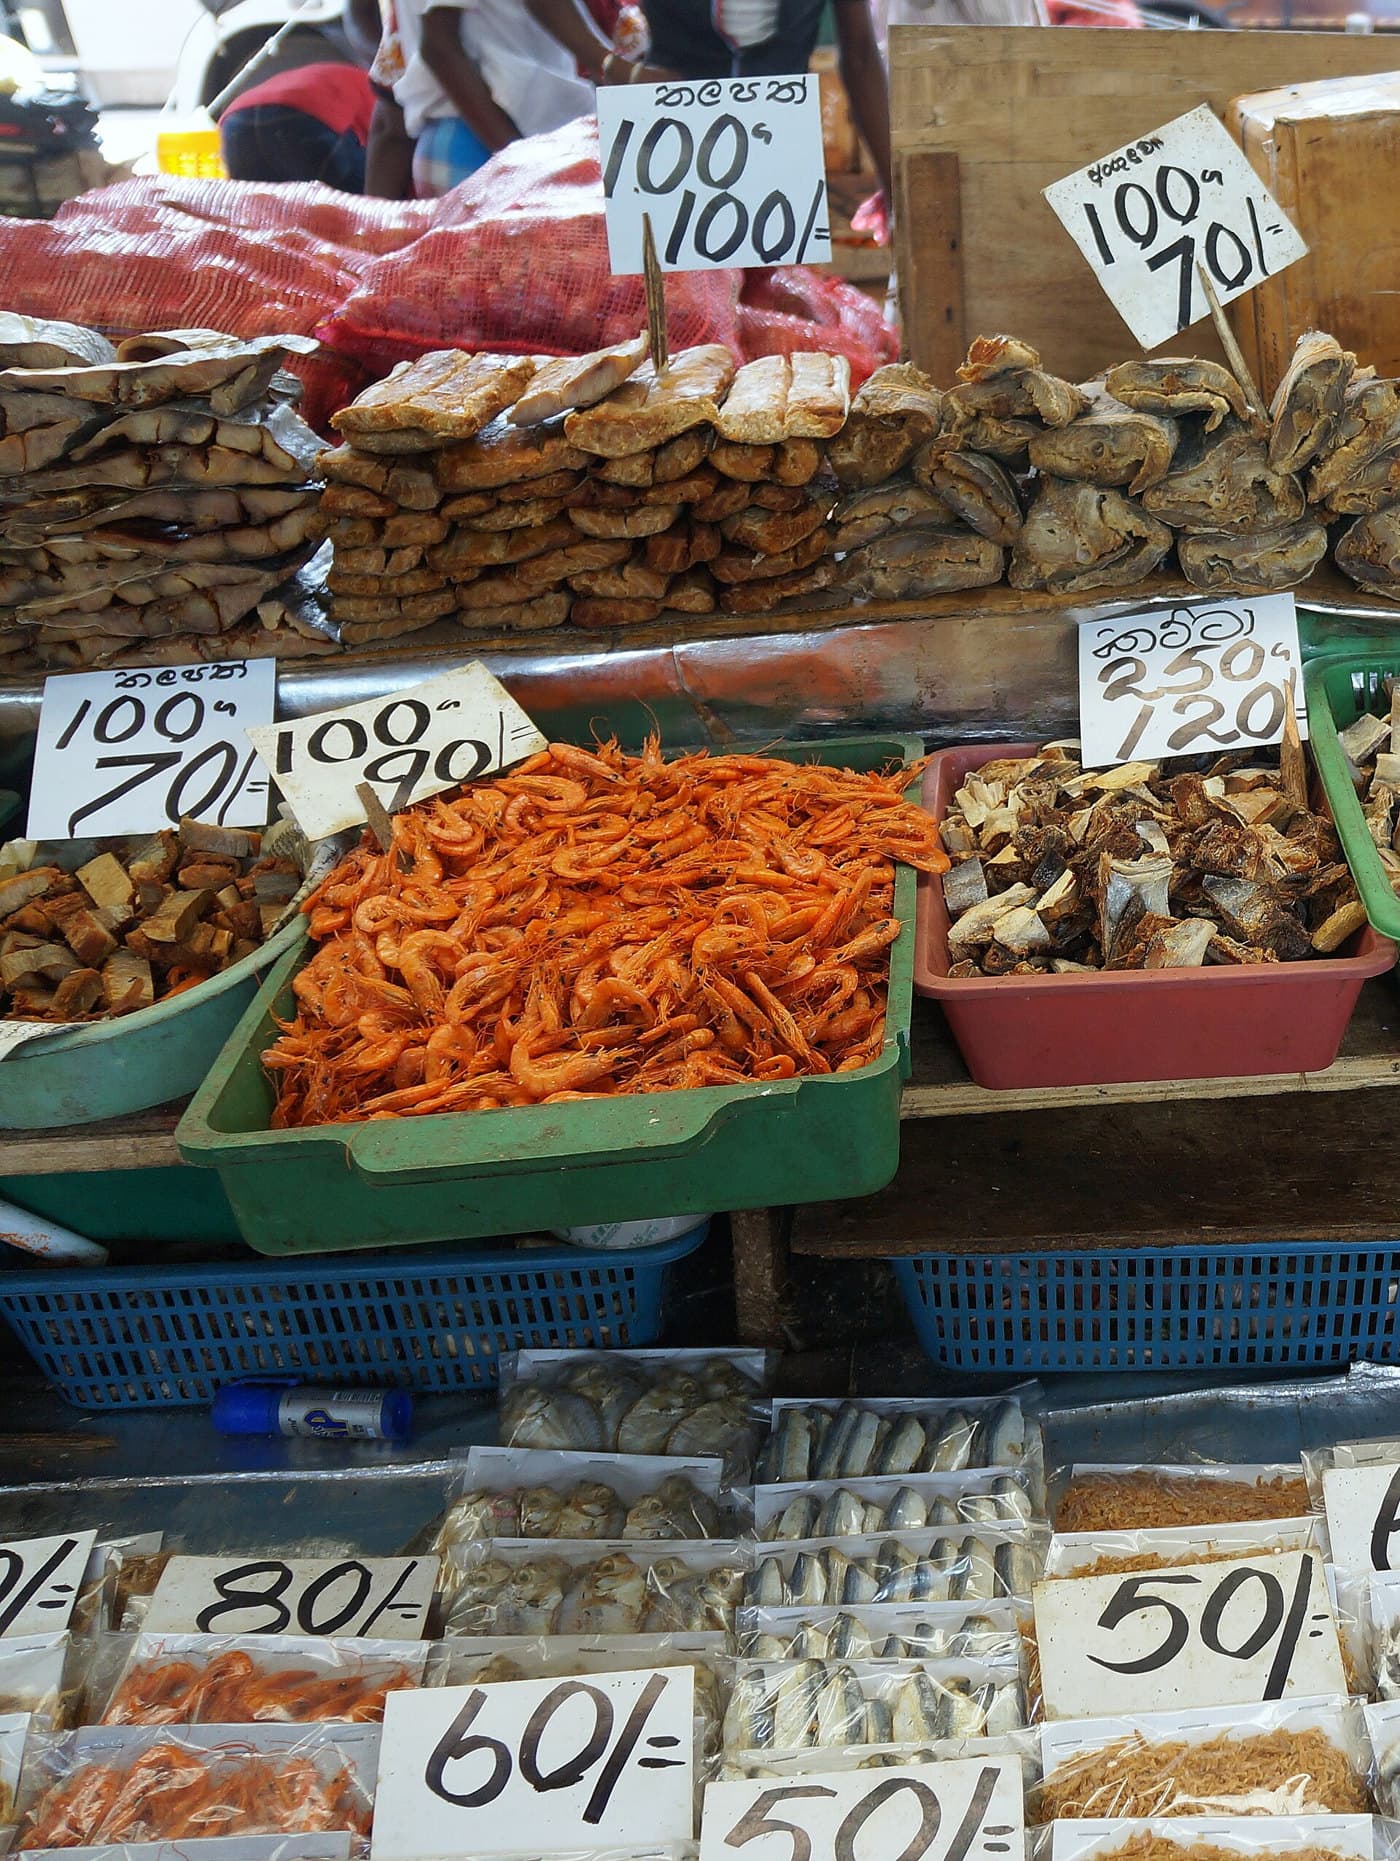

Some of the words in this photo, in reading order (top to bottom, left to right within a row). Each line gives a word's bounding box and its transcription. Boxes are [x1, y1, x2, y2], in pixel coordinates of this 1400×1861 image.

[665, 180, 830, 264] 100/=
[1145, 196, 1283, 332] 70/=
[68, 740, 268, 839] 70/=
[363, 711, 538, 814] 90/=
[196, 1560, 422, 1637] 80/=
[1086, 1553, 1329, 1701] 50/=
[425, 1673, 686, 1825] 60/=
